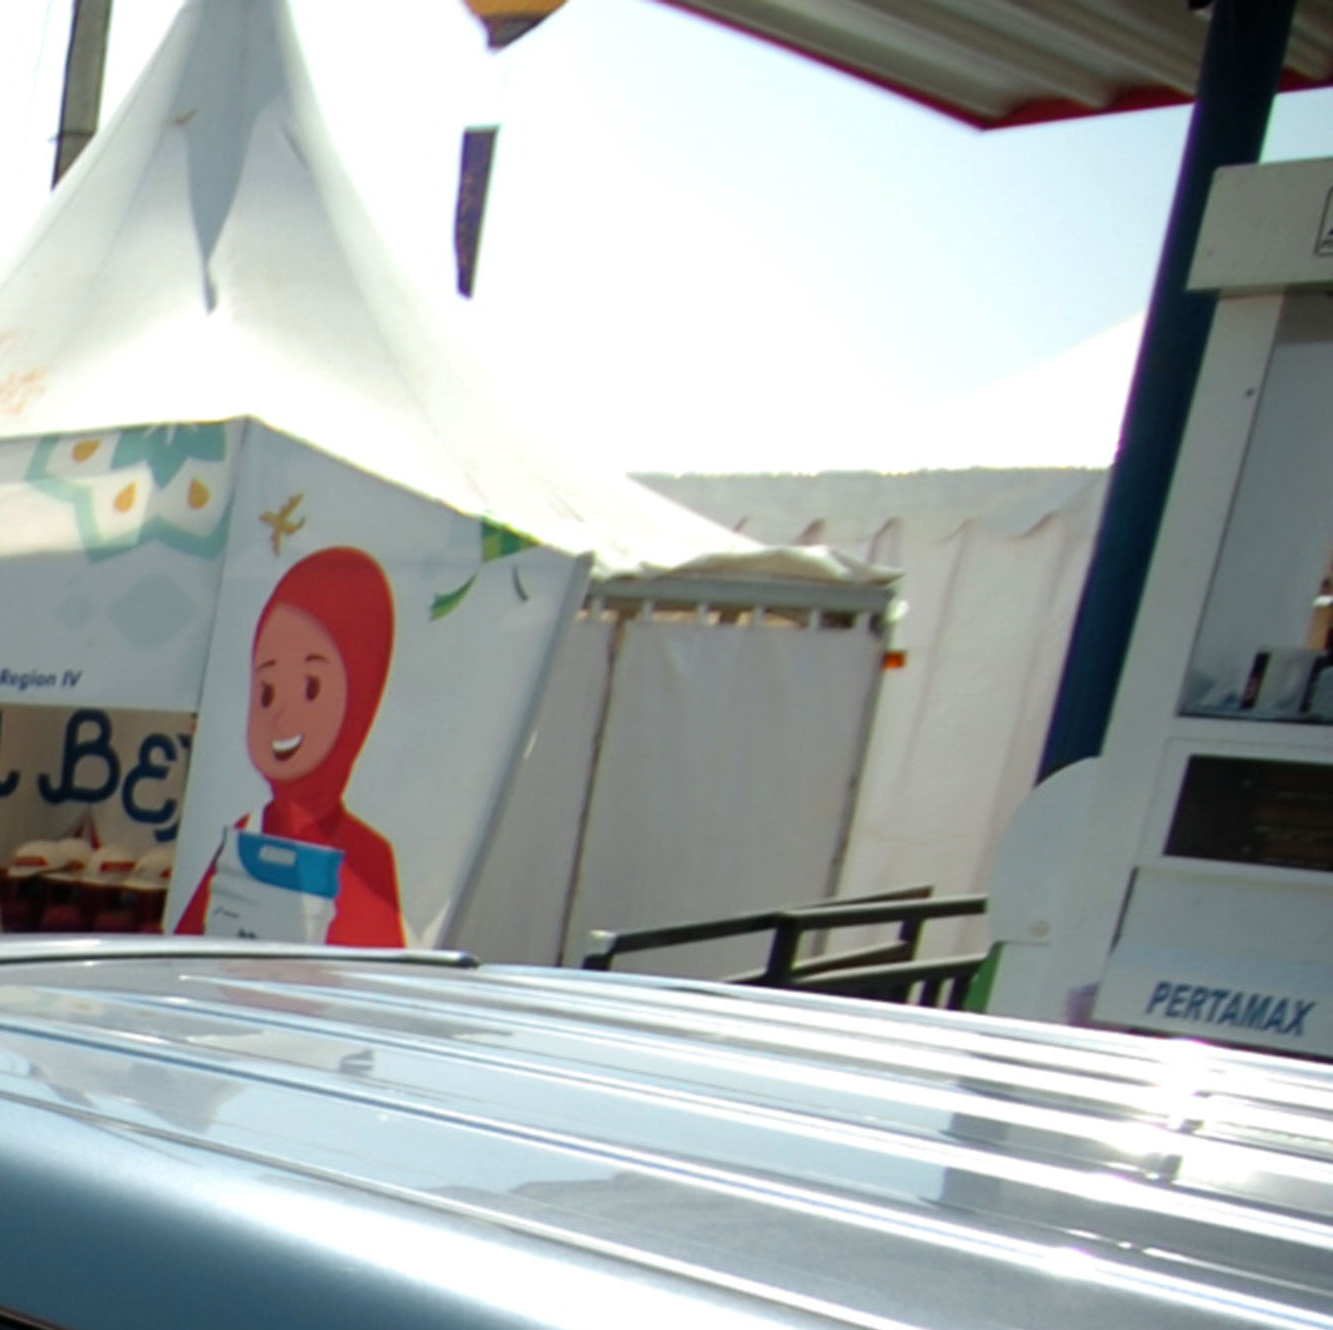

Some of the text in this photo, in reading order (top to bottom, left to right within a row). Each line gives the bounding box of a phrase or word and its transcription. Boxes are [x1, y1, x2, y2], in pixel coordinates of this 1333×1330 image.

[61, 669, 83, 687] IV
[38, 708, 192, 843] BE
[1144, 981, 1316, 1037] PERTAMAX
